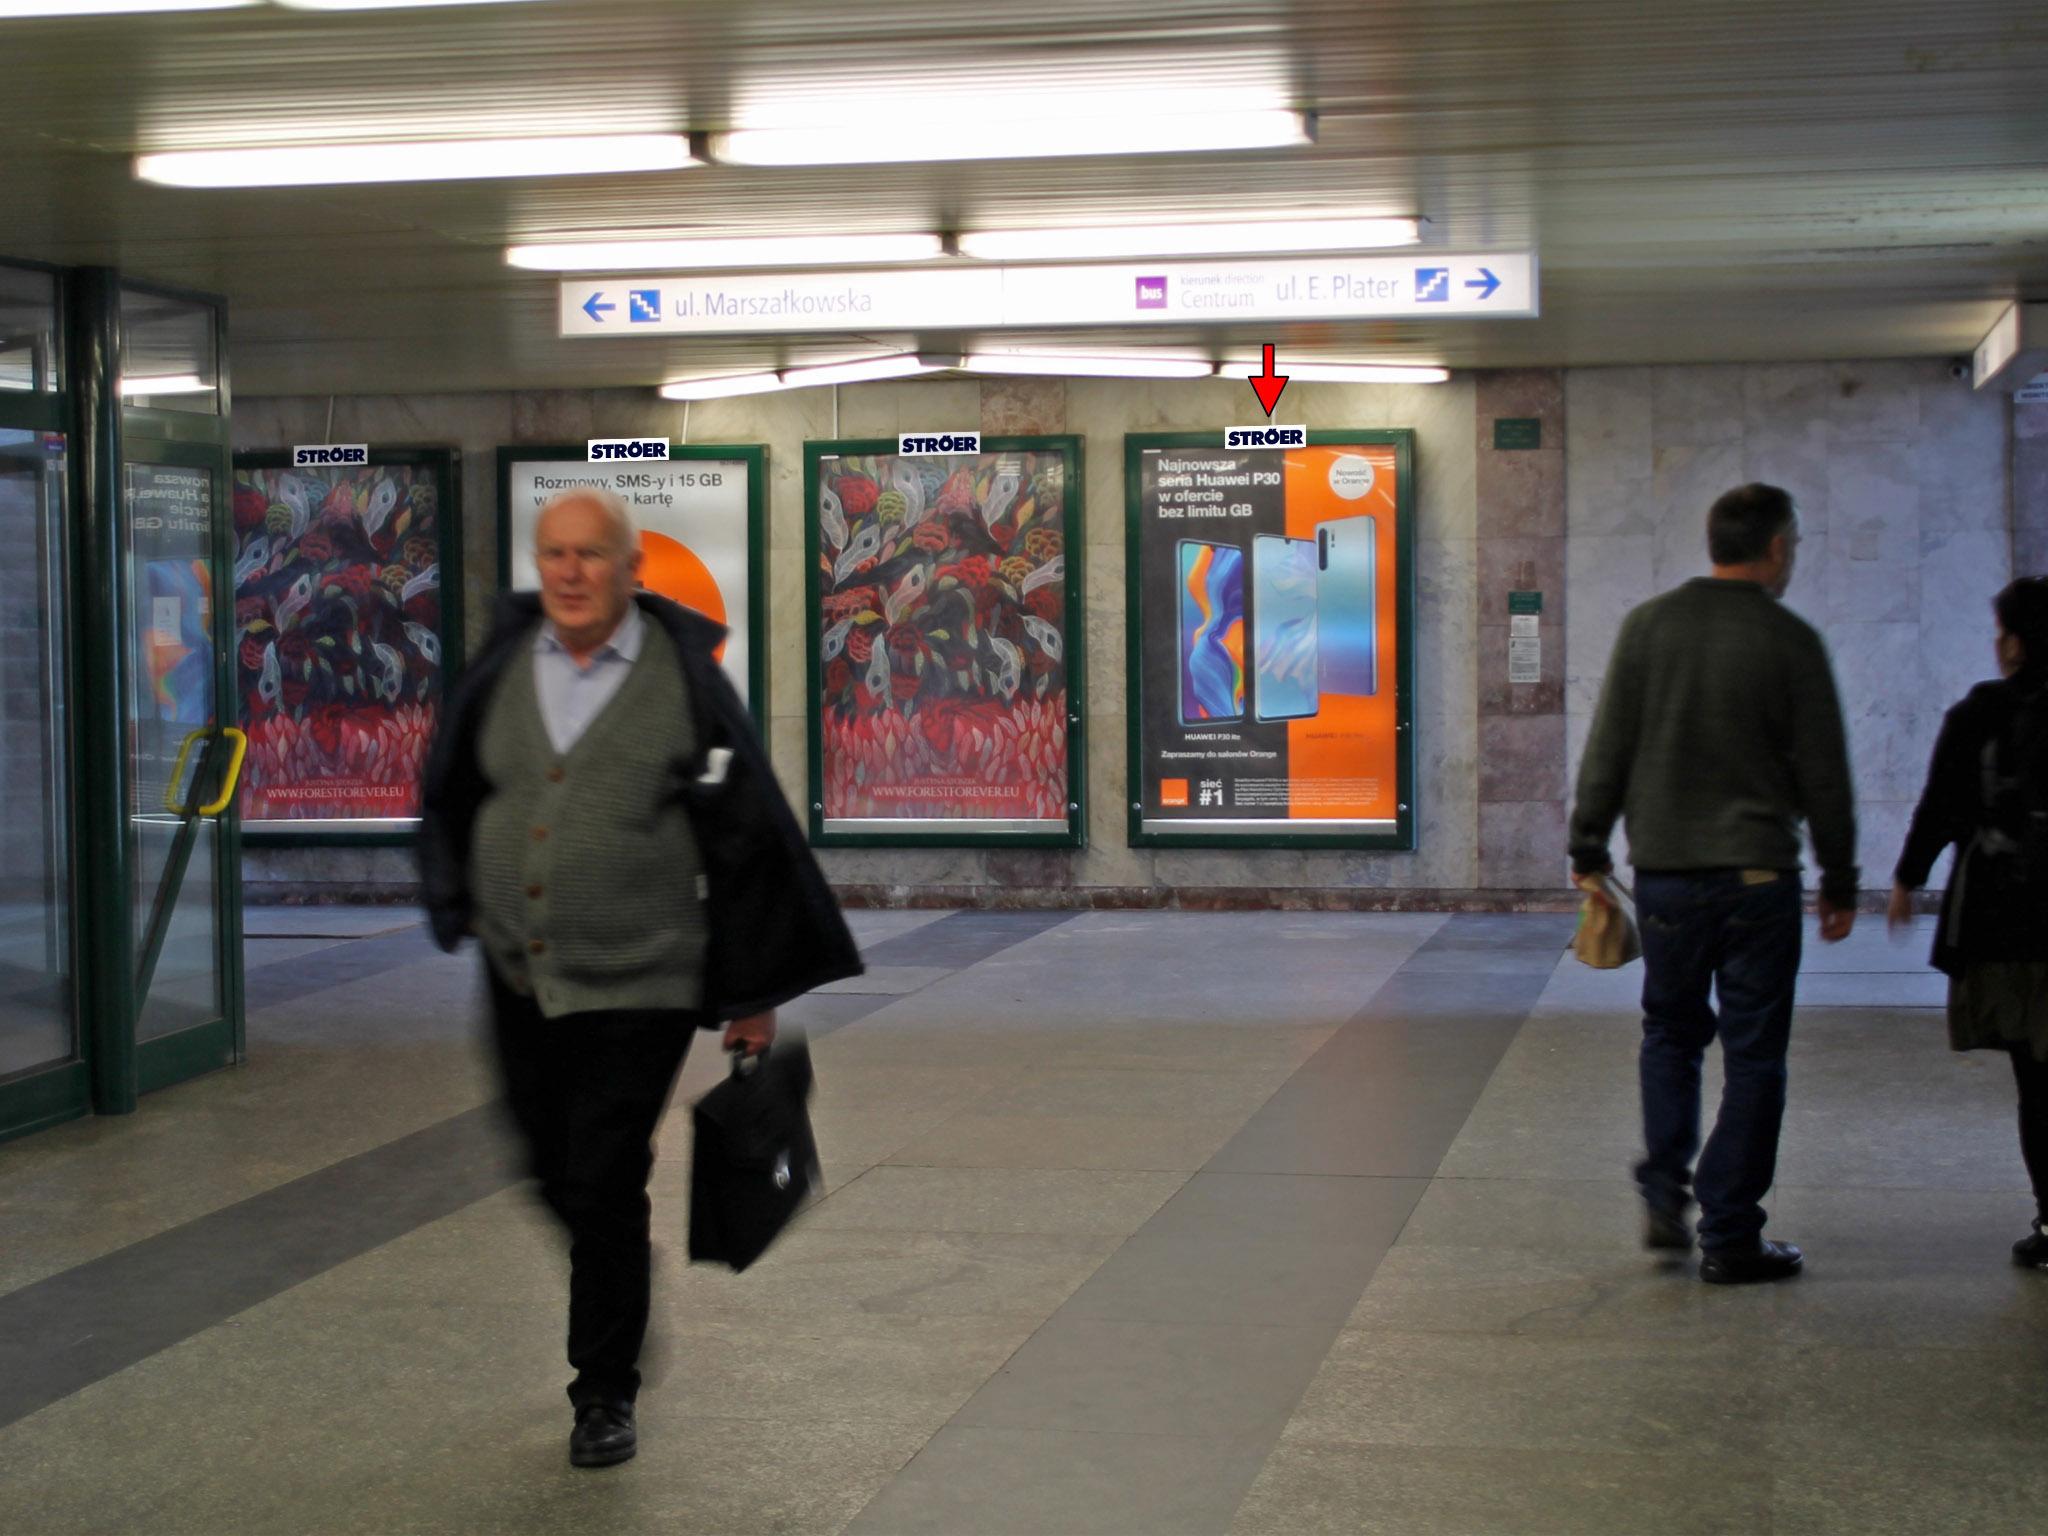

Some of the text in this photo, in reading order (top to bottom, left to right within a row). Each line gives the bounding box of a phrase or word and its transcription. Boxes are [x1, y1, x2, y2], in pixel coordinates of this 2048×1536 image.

[1140, 284, 1163, 300] bus
[1276, 275, 1399, 301] ul. E. Plater
[675, 288, 872, 317] ul. Marszałkowska
[1181, 288, 1255, 309] Centrum
[902, 435, 977, 454] STRÖER
[1228, 429, 1303, 447] STRÖER
[297, 447, 365, 464] STRÖER
[591, 441, 667, 460] STRÖER
[1158, 459, 1236, 473] Najnowsza
[534, 473, 722, 490] Rozmowy, SMS-y i 15 GB
[1158, 472, 1281, 487] seria Huawei P30
[535, 496, 547, 506] w
[634, 492, 673, 507] kartę
[1158, 489, 1224, 502] w ofercie
[1158, 504, 1253, 518] bez limitu GB
[1185, 733, 1217, 741] HUAWEI
[1161, 750, 1277, 760] Zapraszamy do salonów Orange
[1199, 778, 1223, 789] sieć
[266, 786, 404, 799] WWW.FORESTFOREVER.EU
[872, 785, 1019, 798] WWW.FORESTFOREVER.EU
[1199, 789, 1224, 806] #1
